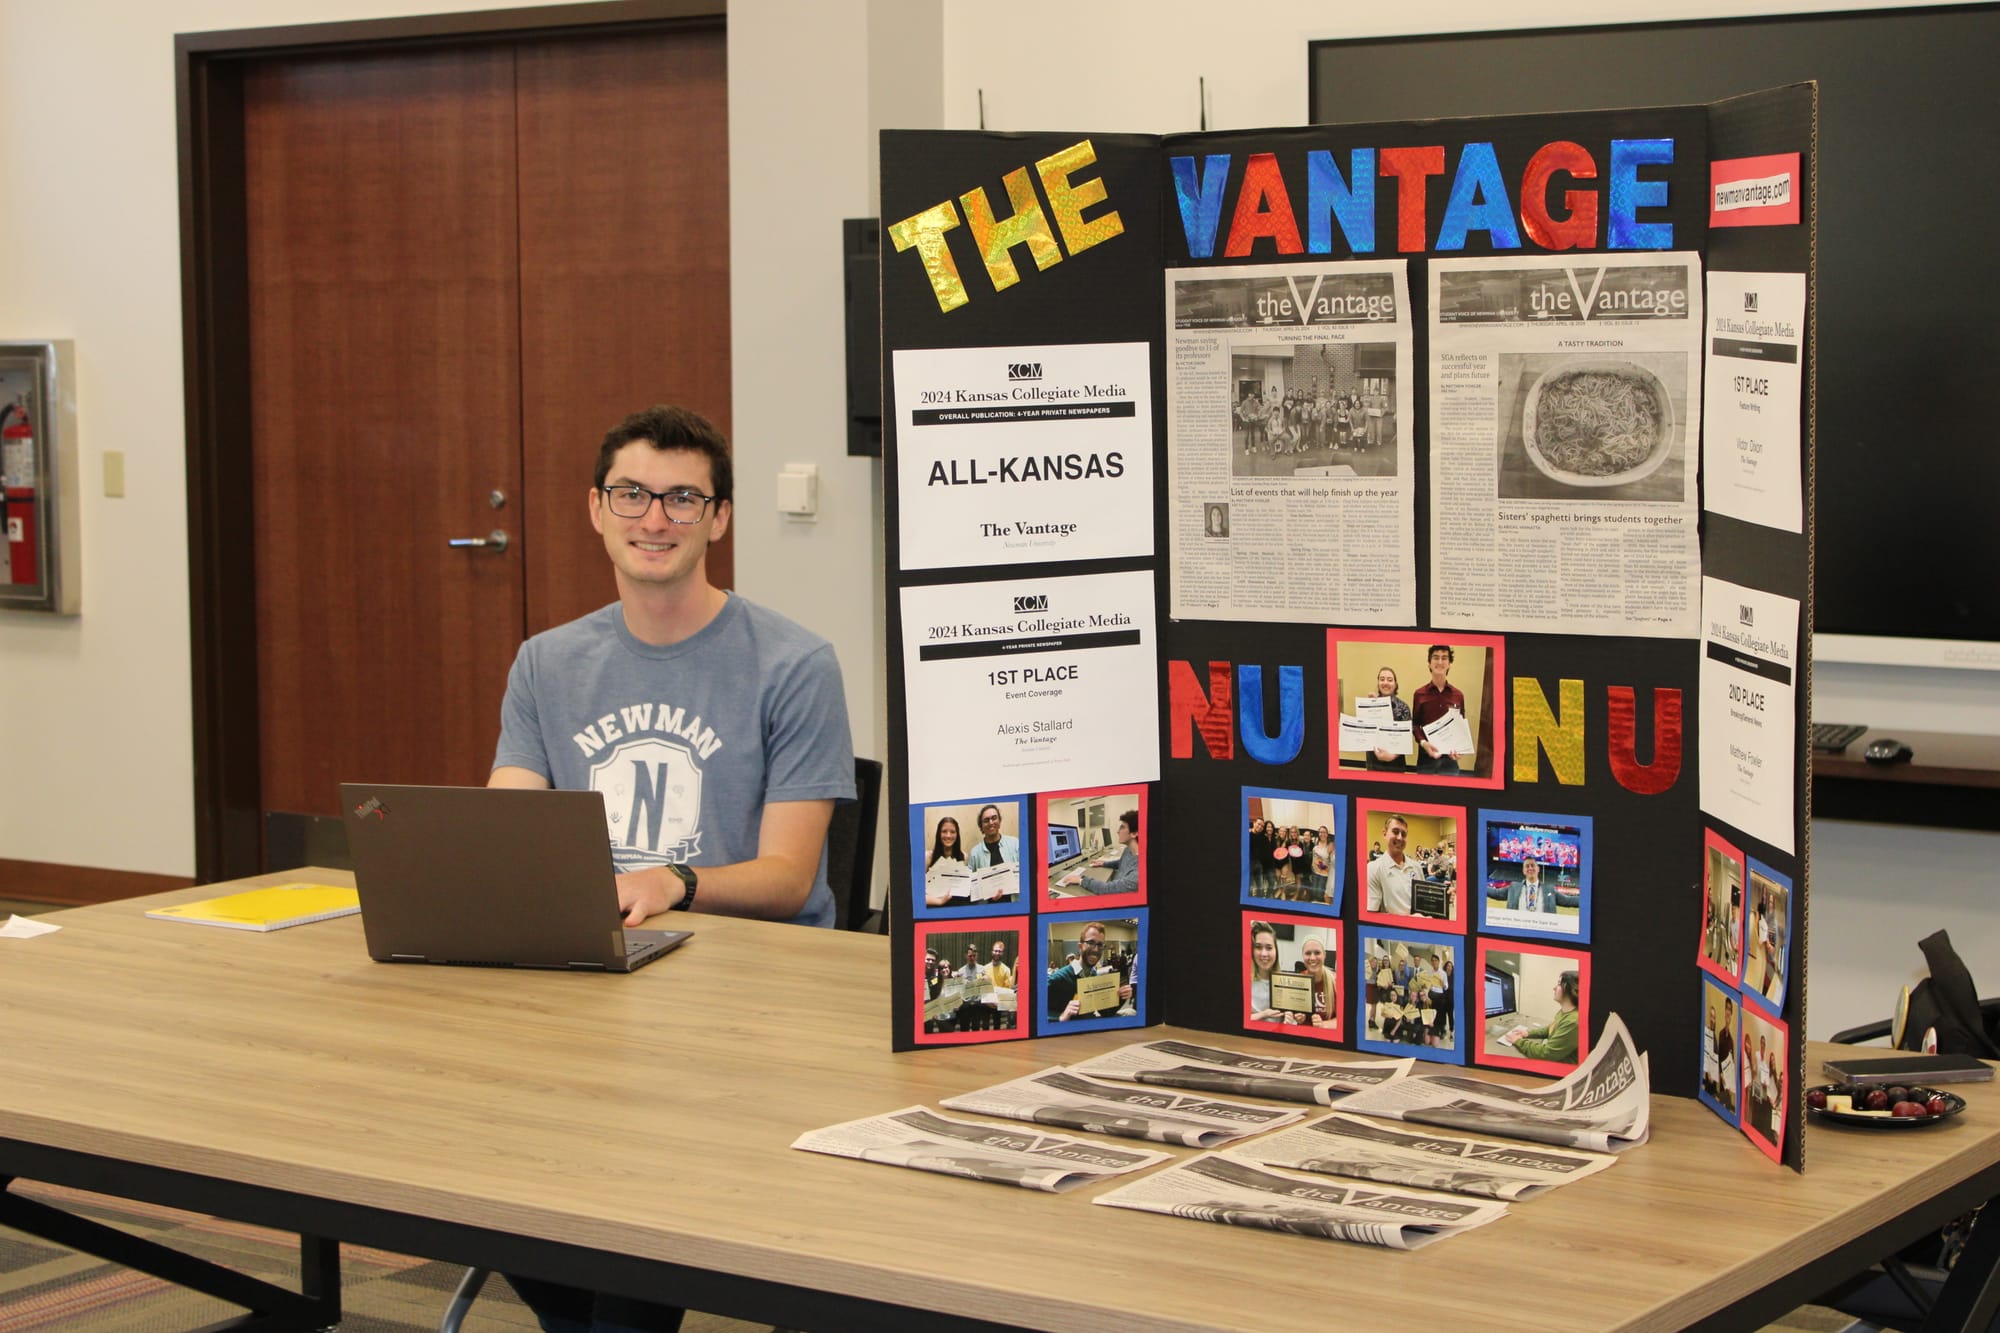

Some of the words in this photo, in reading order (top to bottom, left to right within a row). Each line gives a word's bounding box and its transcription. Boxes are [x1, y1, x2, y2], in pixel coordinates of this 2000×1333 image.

[887, 139, 1125, 314] THE
[1169, 138, 1674, 258] VANTAGE
[1257, 292, 1292, 316] the
[1287, 275, 1393, 325] Vantage
[1530, 284, 1571, 311] the
[1565, 268, 1685, 320] Vantage
[1745, 320, 1774, 340] Collegiate
[1774, 321, 1795, 337] Media
[1441, 353, 1454, 361] SGA
[1455, 353, 1478, 361] reflects
[1441, 362, 1472, 370] successful
[1473, 363, 1487, 371] year
[1008, 363, 1042, 379] KCM
[1441, 371, 1453, 379] and
[1453, 372, 1471, 380] plans
[1471, 371, 1490, 379] future
[921, 391, 952, 404] 2024
[956, 389, 1009, 403] Kansas
[1012, 386, 1081, 402] Collegiate
[1084, 384, 1127, 398] Media
[1734, 376, 1745, 392] 1ST
[1746, 377, 1768, 396] PLACE
[939, 412, 970, 420] OVERALL
[971, 410, 1016, 419] PUBLICATION:
[1017, 409, 1040, 418] 4-YEAR
[1041, 408, 1067, 417] PRIVATE
[1068, 407, 1111, 415] NEWSPAPERS
[928, 452, 1124, 486] ALL-KANSAS
[1231, 488, 1244, 496] List
[1246, 488, 1253, 496] of
[1255, 489, 1278, 497] events
[1281, 488, 1296, 497] that
[1298, 488, 1311, 496] will
[1313, 488, 1329, 498] help
[1331, 488, 1351, 497] finish
[1353, 490, 1363, 498] up
[1365, 488, 1378, 497] the
[1381, 490, 1398, 498] year
[980, 522, 1011, 538] The
[1015, 521, 1077, 538] Vantage
[1531, 513, 1571, 524] spaghetti
[1574, 514, 1601, 524] brings
[1604, 514, 1641, 523] students
[1644, 516, 1683, 526] together
[1014, 595, 1048, 611] KCM
[928, 626, 958, 639] 2024
[961, 622, 1014, 637] Kansas
[1017, 618, 1085, 633] Collegiate
[1089, 613, 1131, 627] Media
[1740, 632, 1769, 654] Collegiate
[1770, 640, 1789, 659] Media
[988, 670, 1018, 686] 1ST
[1024, 665, 1079, 683] PLACE
[1005, 691, 1027, 700] Event
[1028, 688, 1063, 699] Coverage
[1729, 684, 1741, 702] 2ND
[1742, 688, 1765, 711] PLACE
[1168, 660, 1304, 765] NU
[572, 703, 722, 761] NEWMAN
[997, 723, 1030, 735] Alexis
[1033, 718, 1073, 732] Stallard
[1513, 677, 1682, 795] NU
[1030, 736, 1057, 744] Vantage
[626, 760, 668, 852] N
[1237, 1061, 1278, 1071] the
[1280, 1060, 1383, 1084] Vantage
[1518, 1097, 1560, 1108] the
[1562, 1056, 1632, 1112] Vantage
[1125, 1095, 1167, 1107] the
[1167, 1095, 1271, 1122] Vantage
[984, 1136, 1026, 1150] the
[1023, 1136, 1130, 1167] Vantage
[1412, 1142, 1458, 1154] the
[1461, 1143, 1576, 1170] Vantage
[1290, 1188, 1339, 1201] the
[1341, 1190, 1462, 1219] Vantage
